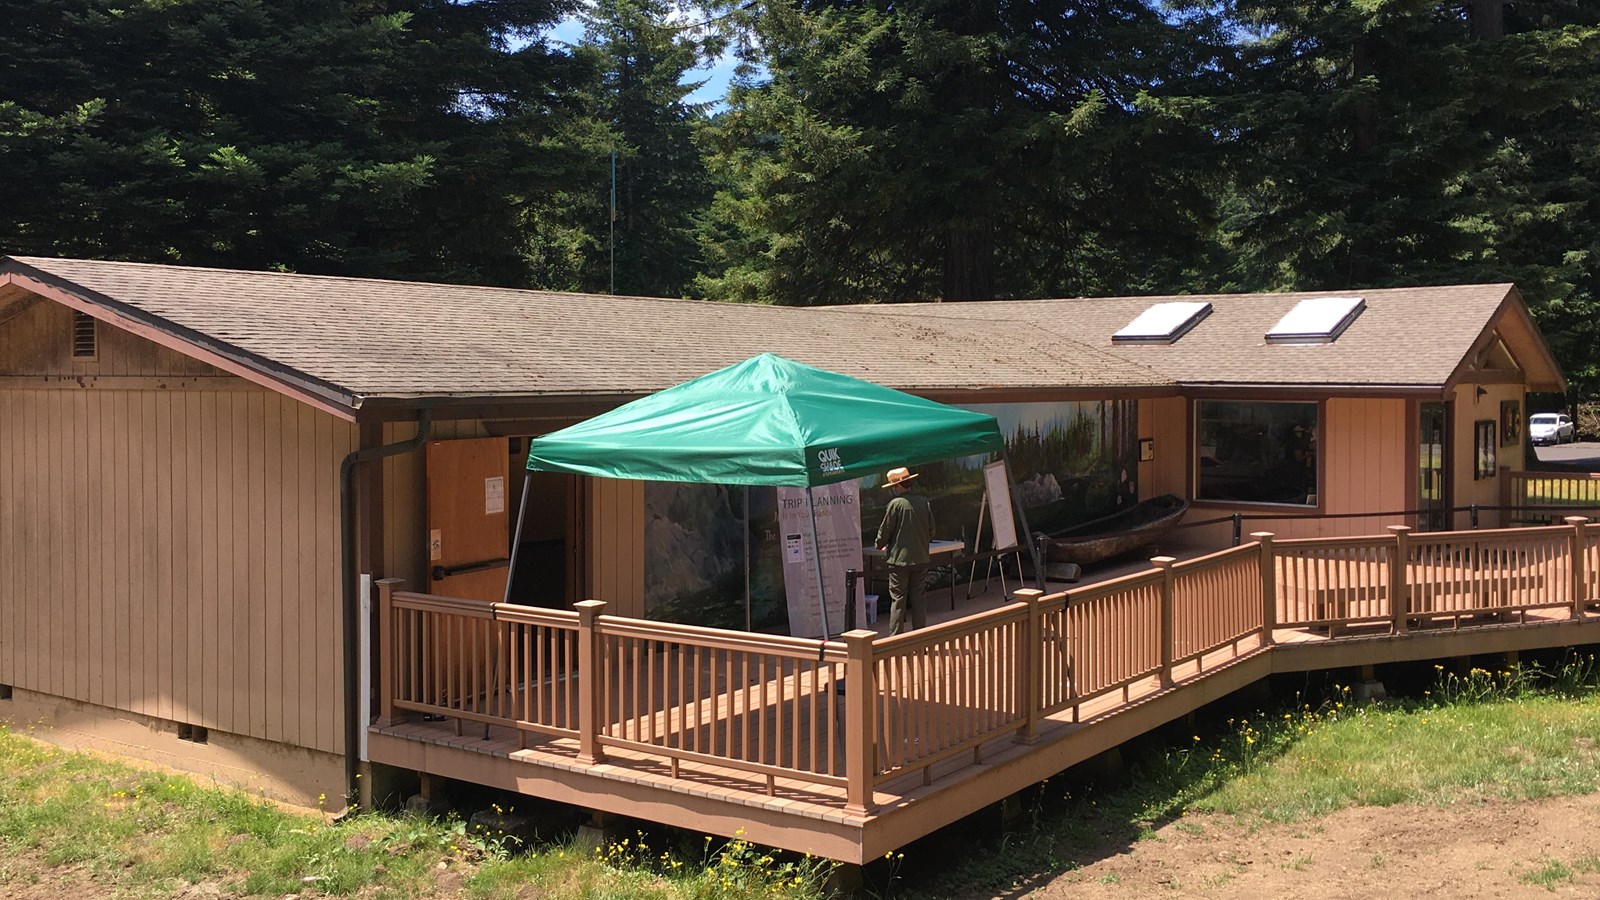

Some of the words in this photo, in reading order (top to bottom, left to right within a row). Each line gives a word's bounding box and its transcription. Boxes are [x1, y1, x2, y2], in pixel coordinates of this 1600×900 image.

[818, 448, 840, 462] QUIK
[820, 460, 844, 472] SHADE
[781, 498, 803, 509] TRIP
[805, 495, 853, 507] ANNING
[764, 530, 776, 540] The
